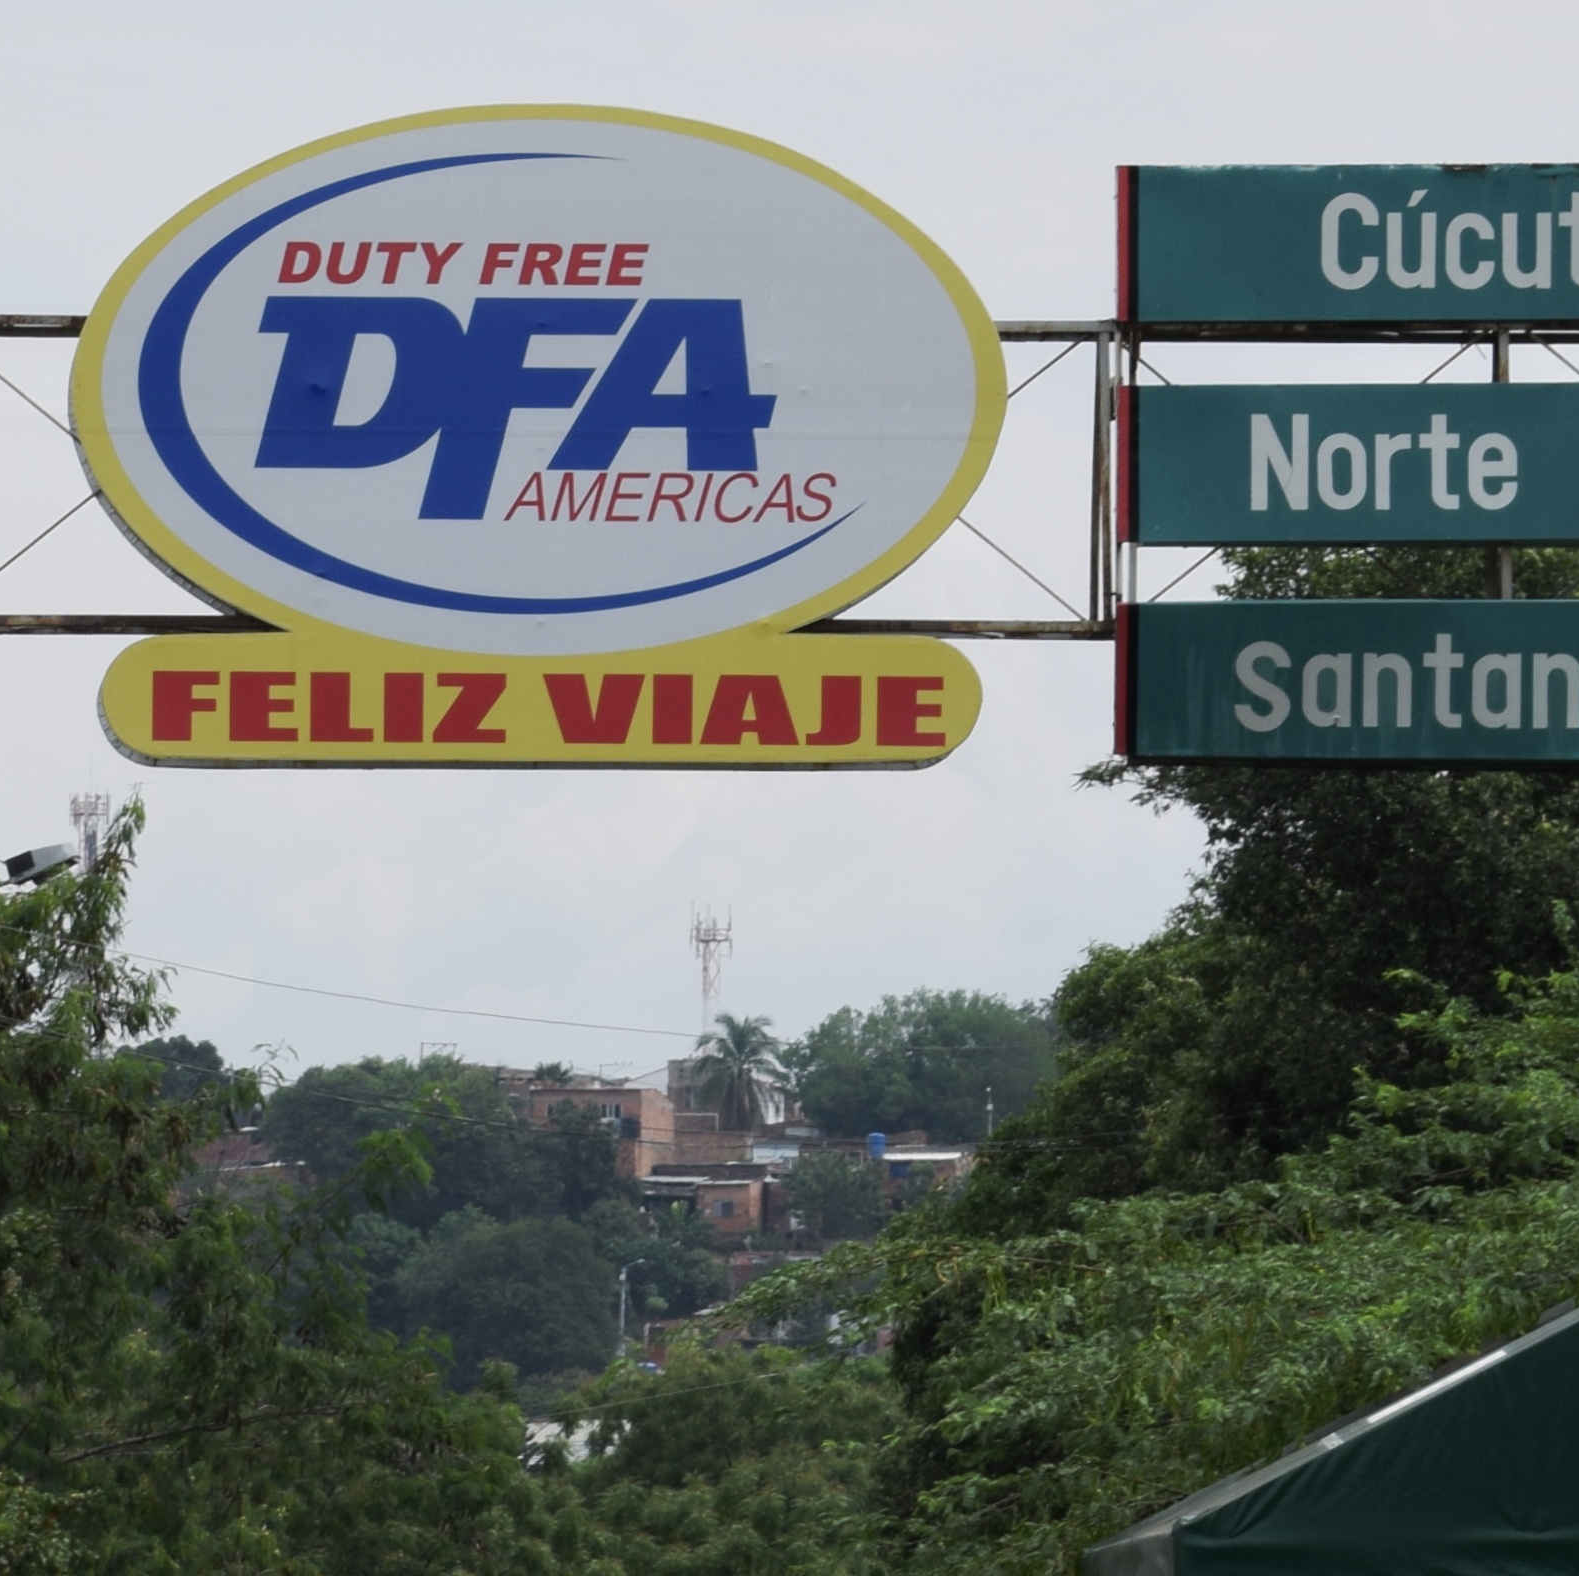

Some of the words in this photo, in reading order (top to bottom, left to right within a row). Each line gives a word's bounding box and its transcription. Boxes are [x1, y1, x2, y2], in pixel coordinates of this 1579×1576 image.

[277, 239, 463, 286] DUTY
[478, 241, 651, 287] FREE
[253, 295, 778, 521] DFA
[503, 470, 840, 524] AMERICAS
[1249, 411, 1520, 511] Norte
[150, 669, 509, 745] FELIZ
[543, 673, 947, 748] VIAJE
